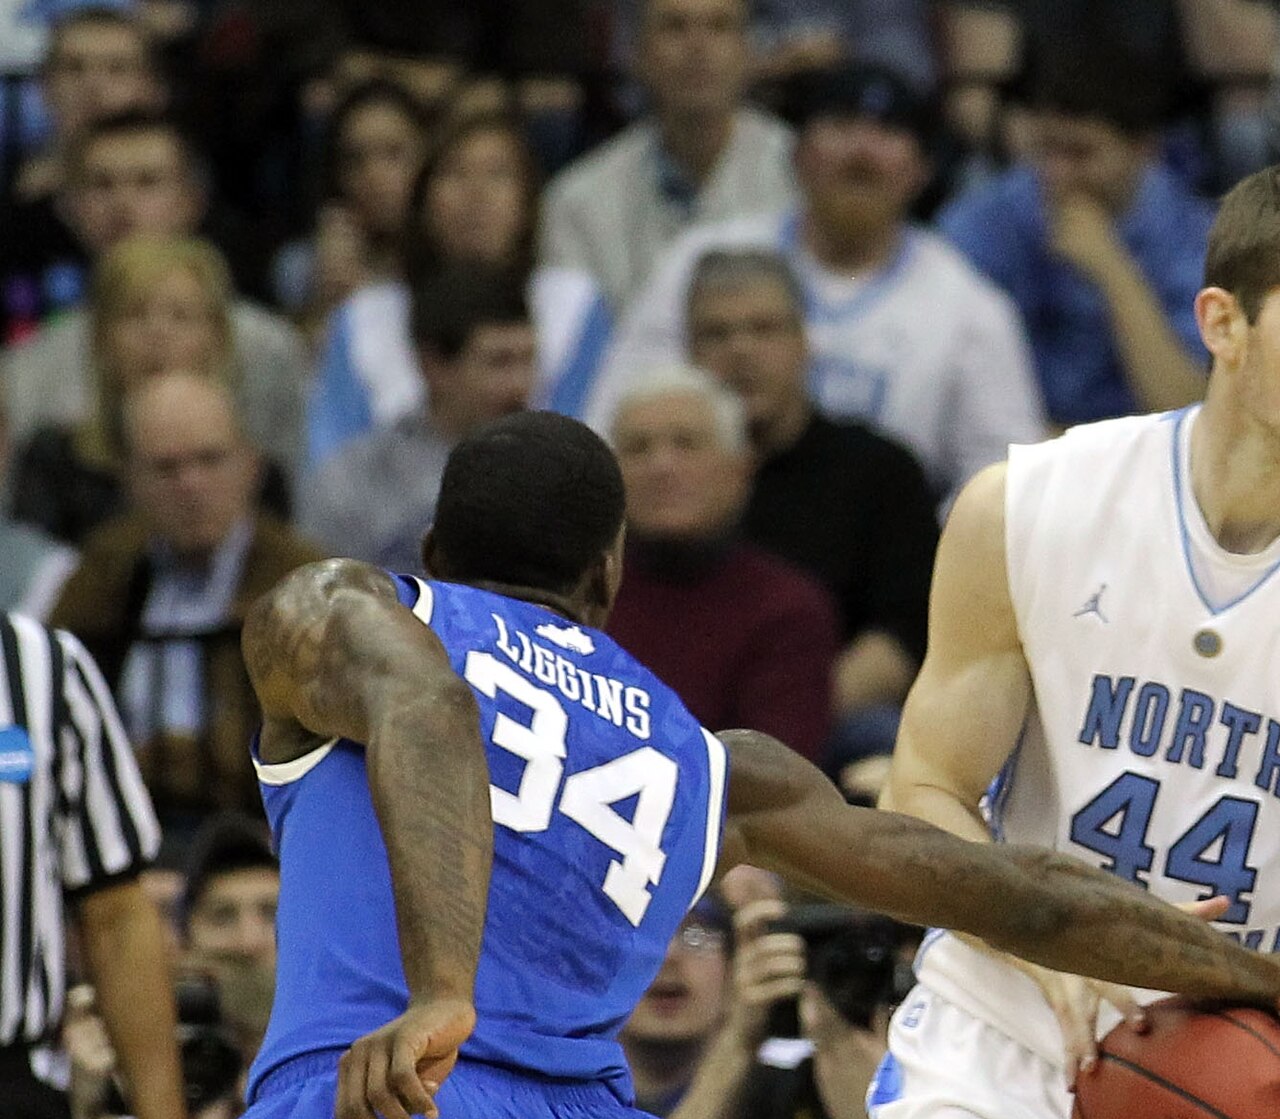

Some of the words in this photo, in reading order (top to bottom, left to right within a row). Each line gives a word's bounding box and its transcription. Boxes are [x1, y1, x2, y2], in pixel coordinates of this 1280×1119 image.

[491, 612, 651, 740] LIGGINS
[464, 650, 679, 928] 34
[1069, 770, 1260, 926] 44
